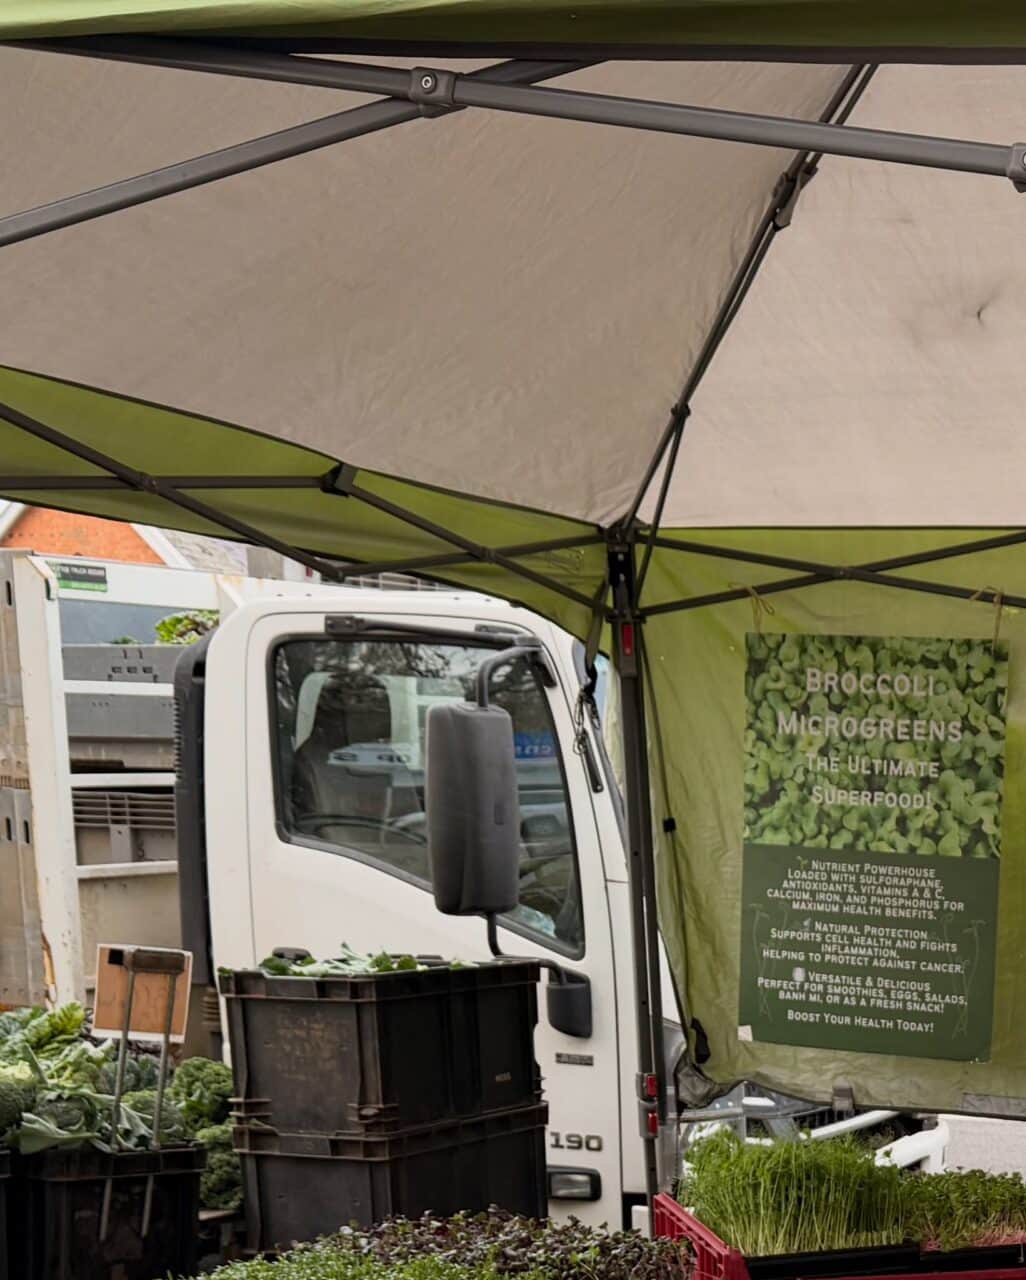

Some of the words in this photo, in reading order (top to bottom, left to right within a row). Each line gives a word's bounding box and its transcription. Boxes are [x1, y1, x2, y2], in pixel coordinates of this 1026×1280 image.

[806, 668, 934, 696] BROCCOLI
[777, 712, 963, 743] MICROGREENS
[806, 753, 839, 773] THE
[848, 755, 940, 778] ULTIMATE
[812, 786, 932, 809] SUPERFOOD!
[788, 870, 827, 881] LOADED
[831, 873, 855, 882] WITH
[812, 861, 860, 873] NUTRIENT
[864, 864, 935, 878] POWERHOUSE
[861, 885, 908, 896] VITAMINS
[912, 887, 919, 897] A
[923, 888, 931, 898] &
[792, 901, 839, 913] MAXIMUM
[843, 905, 881, 916] HEALTH
[846, 895, 867, 904] AND
[871, 896, 939, 909] PHOSPHORUS
[944, 901, 964, 911] FOR
[771, 929, 822, 942] SUPPORTS
[825, 934, 849, 944] CELL
[853, 936, 892, 947] HEALTH
[896, 940, 917, 949] AND
[921, 941, 957, 952] FIGHTS
[815, 921, 860, 935] NATURAL
[864, 925, 927, 939] PROTECTION
[763, 949, 805, 961] HELPING
[809, 953, 821, 962] TO
[825, 954, 869, 966] PROTECT
[873, 958, 916, 970] AGAINST
[758, 978, 801, 990] PERFECT
[804, 983, 823, 992] FOR
[809, 972, 862, 986] VERSATILE
[865, 976, 873, 987] &
[877, 978, 930, 991] DELICIOUS
[779, 991, 806, 1001] BANH
[826, 995, 840, 1004] OR
[844, 996, 856, 1005] AS
[860, 997, 866, 1006] A
[871, 999, 903, 1009] FRESH
[907, 1000, 944, 1013] SNACK!
[788, 1010, 820, 1022] BOOST
[824, 1013, 851, 1025] YOUR
[855, 1016, 893, 1029] HEALTH
[897, 1020, 933, 1033] TODAY!
[550, 1131, 603, 1152] 190
